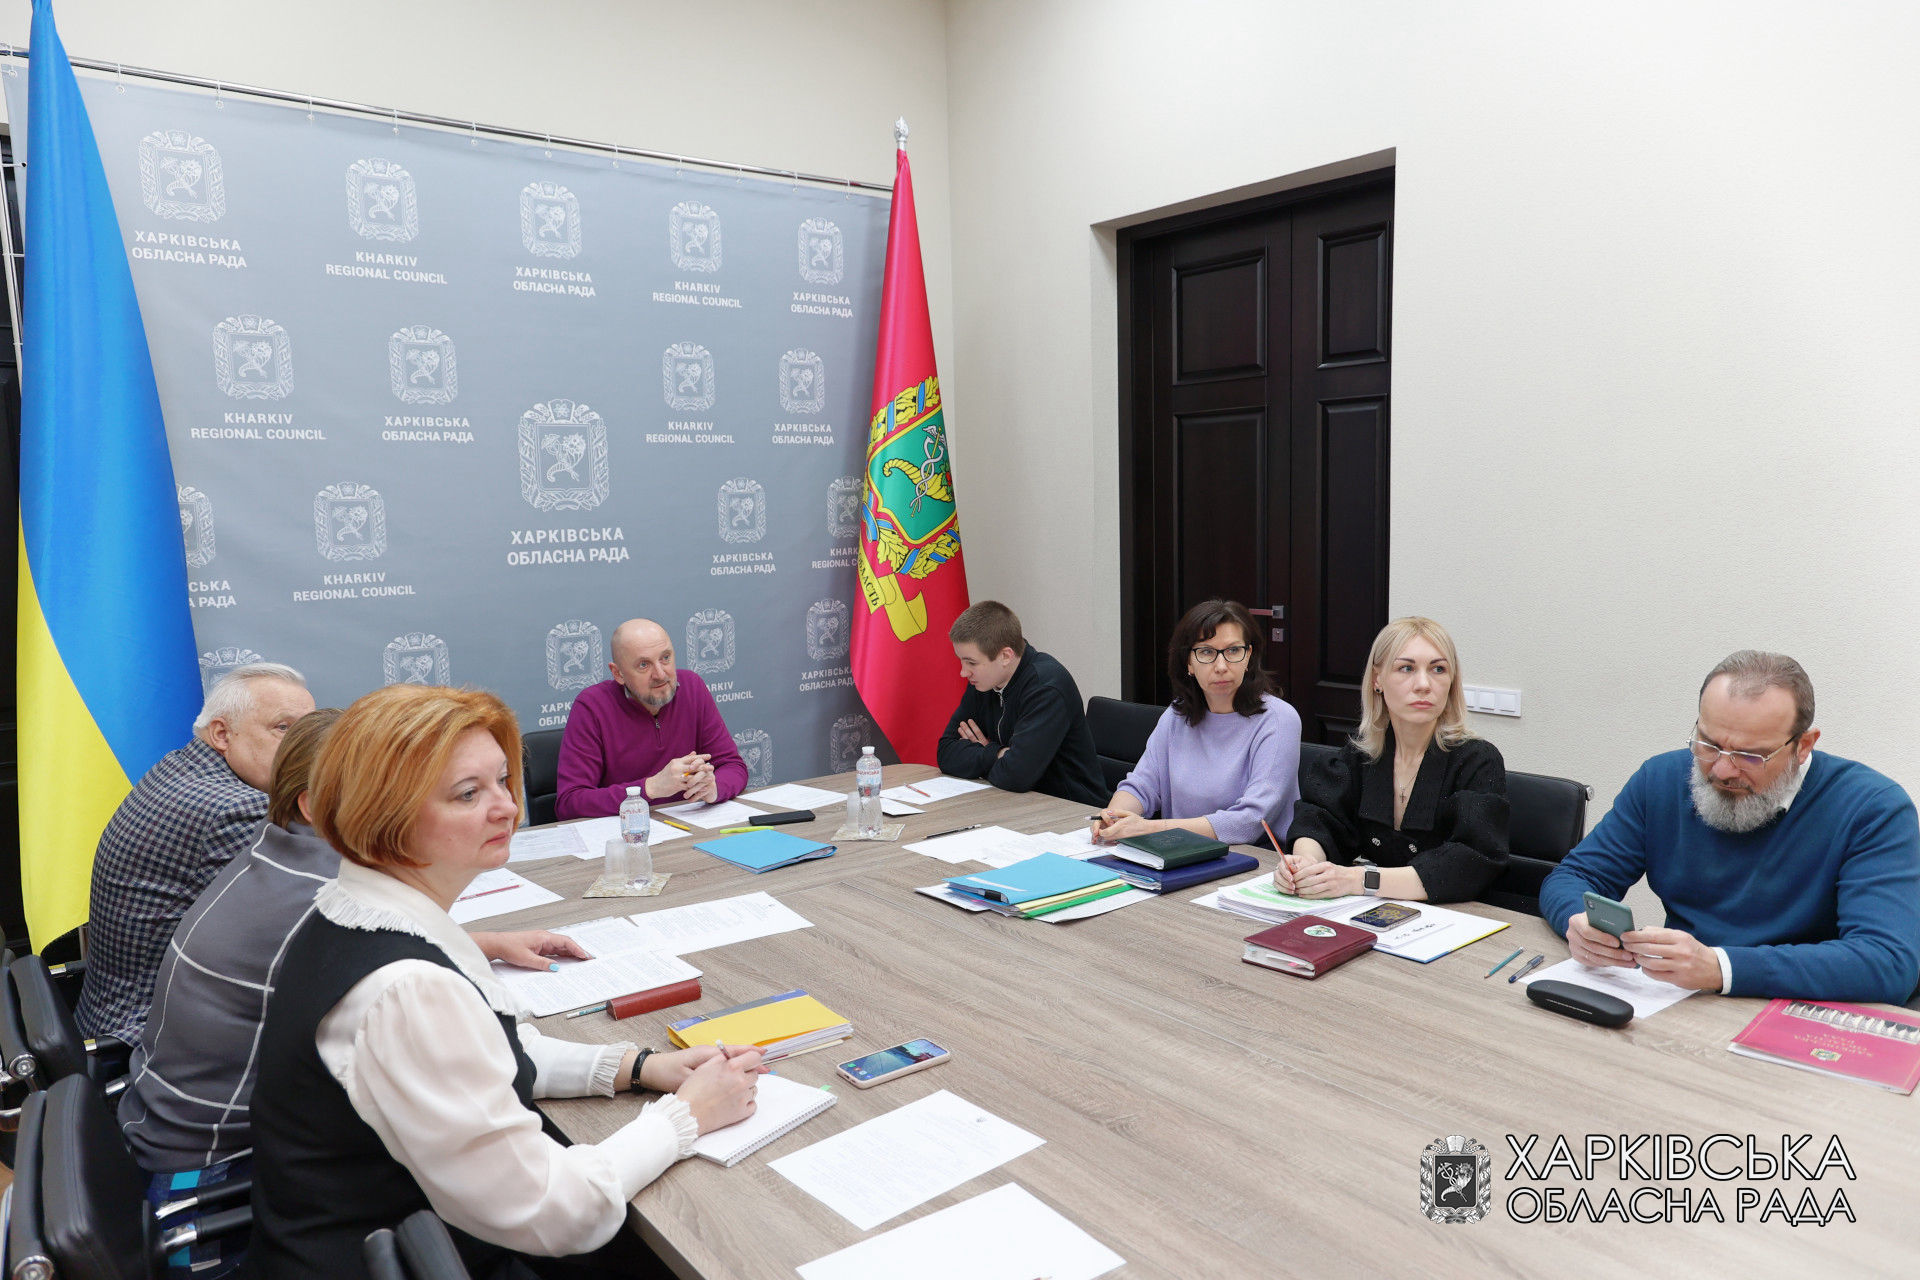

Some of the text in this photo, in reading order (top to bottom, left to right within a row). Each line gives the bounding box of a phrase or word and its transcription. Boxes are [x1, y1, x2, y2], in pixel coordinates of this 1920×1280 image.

[134, 231, 242, 251] ХАРКІВСЬКА
[131, 247, 248, 269] ОБЛАСНА РАДА
[355, 252, 418, 266] KHARKIV
[325, 264, 448, 284] REGIONAL COUNCIL
[515, 267, 593, 282] ХАРКІВСЬКА
[512, 281, 596, 298] ОБЛАСНА РАДА
[674, 281, 721, 293] KHARKIV
[652, 292, 743, 308] REGIONAL COUNCIL
[792, 292, 851, 305] ХАРКІВСЬКА
[790, 304, 854, 318] ОБЛАСНА РАДА
[224, 413, 293, 424] KHARKIV
[383, 416, 471, 427] ХАРКІВСЬКА
[667, 421, 714, 431] KHARKIV
[774, 424, 832, 432] ХАРКІВСЬКА
[190, 428, 327, 440] REGIONAL COUNCIL
[381, 431, 475, 443] ОБЛАСНА РАДА
[645, 434, 736, 443] REGIONAL COUNCIL
[771, 435, 835, 446] ОБЛАСНА РАДА
[510, 527, 625, 544] ХАРКІВСЬКА
[506, 547, 631, 565] ОБЛАСНА РАДА
[712, 552, 774, 563] ХАРКІВСЬКА
[829, 547, 858, 557] KHARK
[710, 564, 777, 576] ОБЛАСНА РАДА
[811, 559, 850, 568] REGIONAL
[323, 572, 386, 585] KHARKIV
[292, 585, 417, 601] REGIONAL COUNCIL
[198, 595, 238, 608] РАДА
[801, 666, 852, 681] ХАРКІВСЬК
[799, 676, 855, 691] ОБЛАСНА РАД
[716, 690, 754, 703] COUNCIL
[540, 701, 573, 714] ХАРК
[538, 714, 569, 727] ОБЛА
